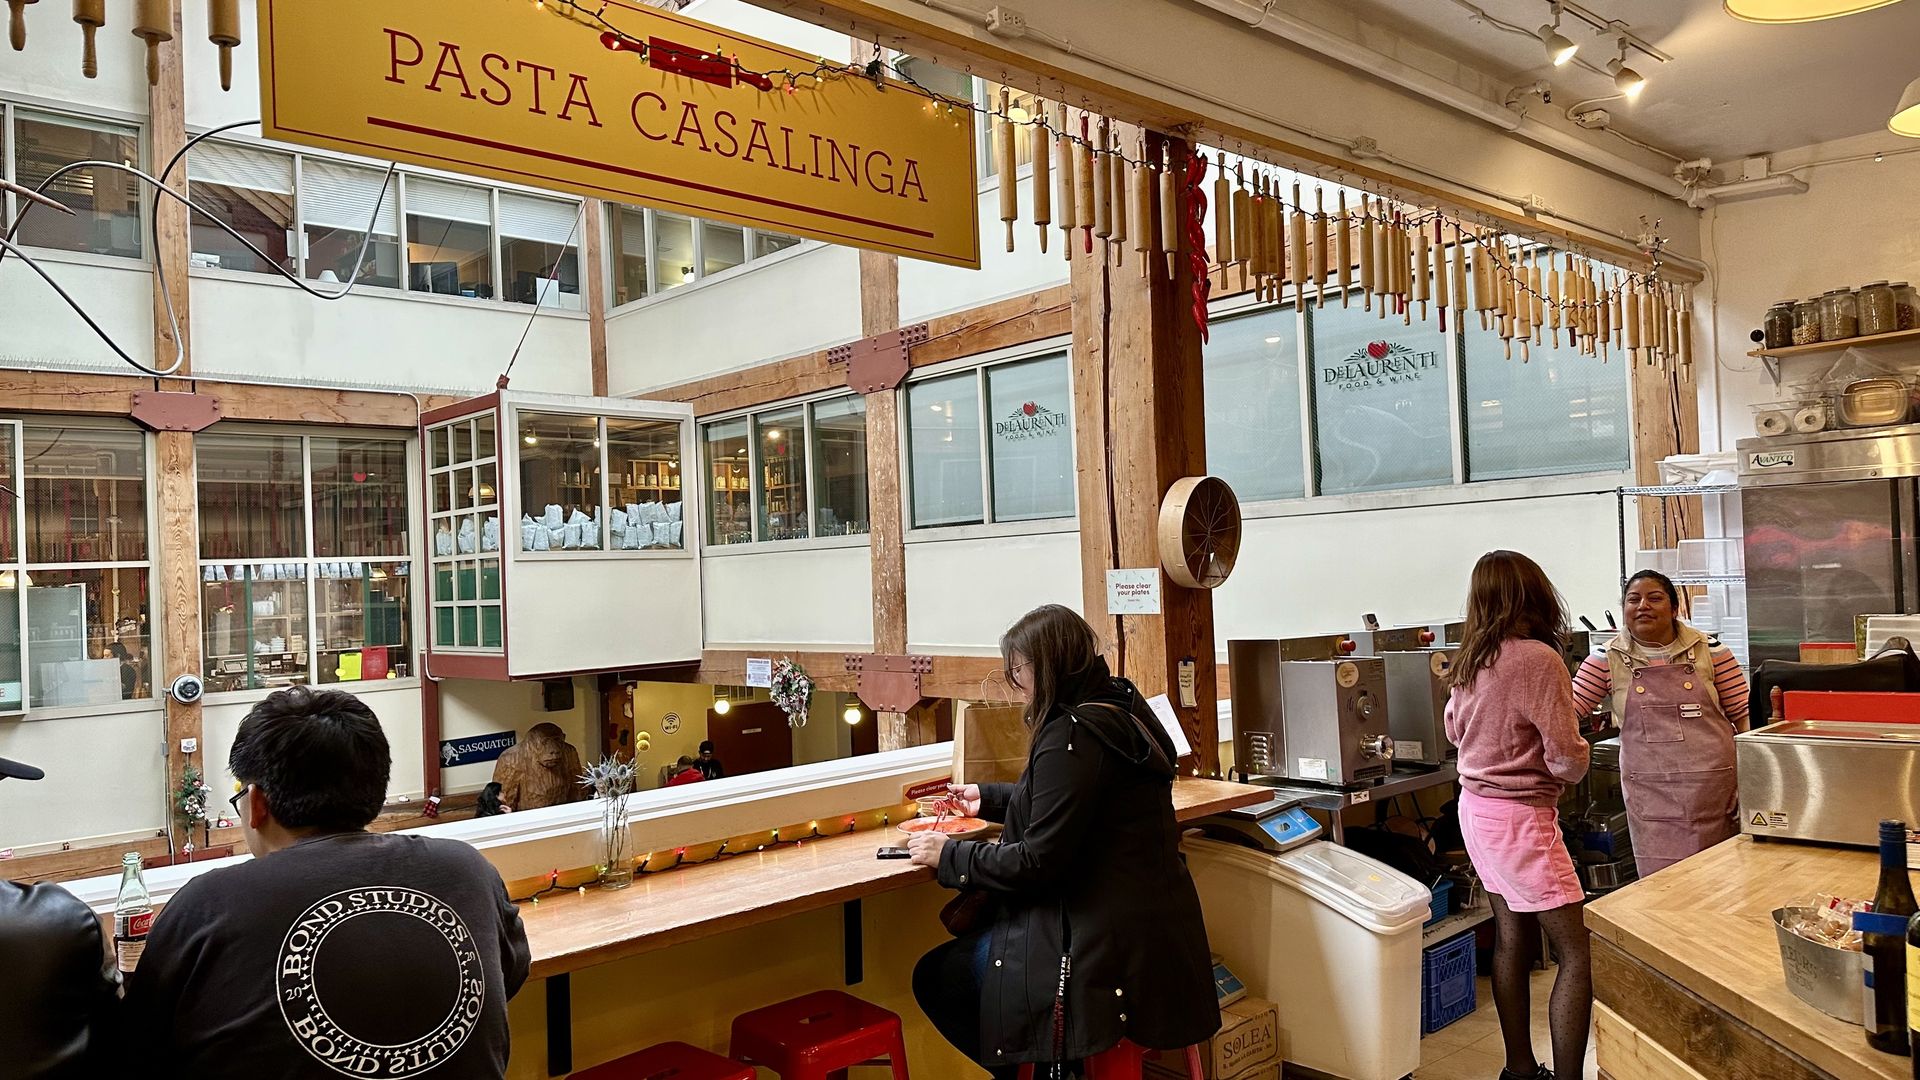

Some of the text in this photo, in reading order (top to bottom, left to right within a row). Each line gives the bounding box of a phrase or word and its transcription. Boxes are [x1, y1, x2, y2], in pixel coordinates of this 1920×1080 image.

[383, 28, 929, 204] PASTA CASALINGA
[1338, 381, 1369, 390] FOOD
[1389, 372, 1420, 382] WINE
[1751, 454, 1794, 467] AVANTCO
[1131, 589, 1150, 597] plates
[458, 736, 515, 754] SASQUATCH
[283, 890, 468, 979] BOND STUDIOS
[1223, 1024, 1272, 1060] SOLEA
